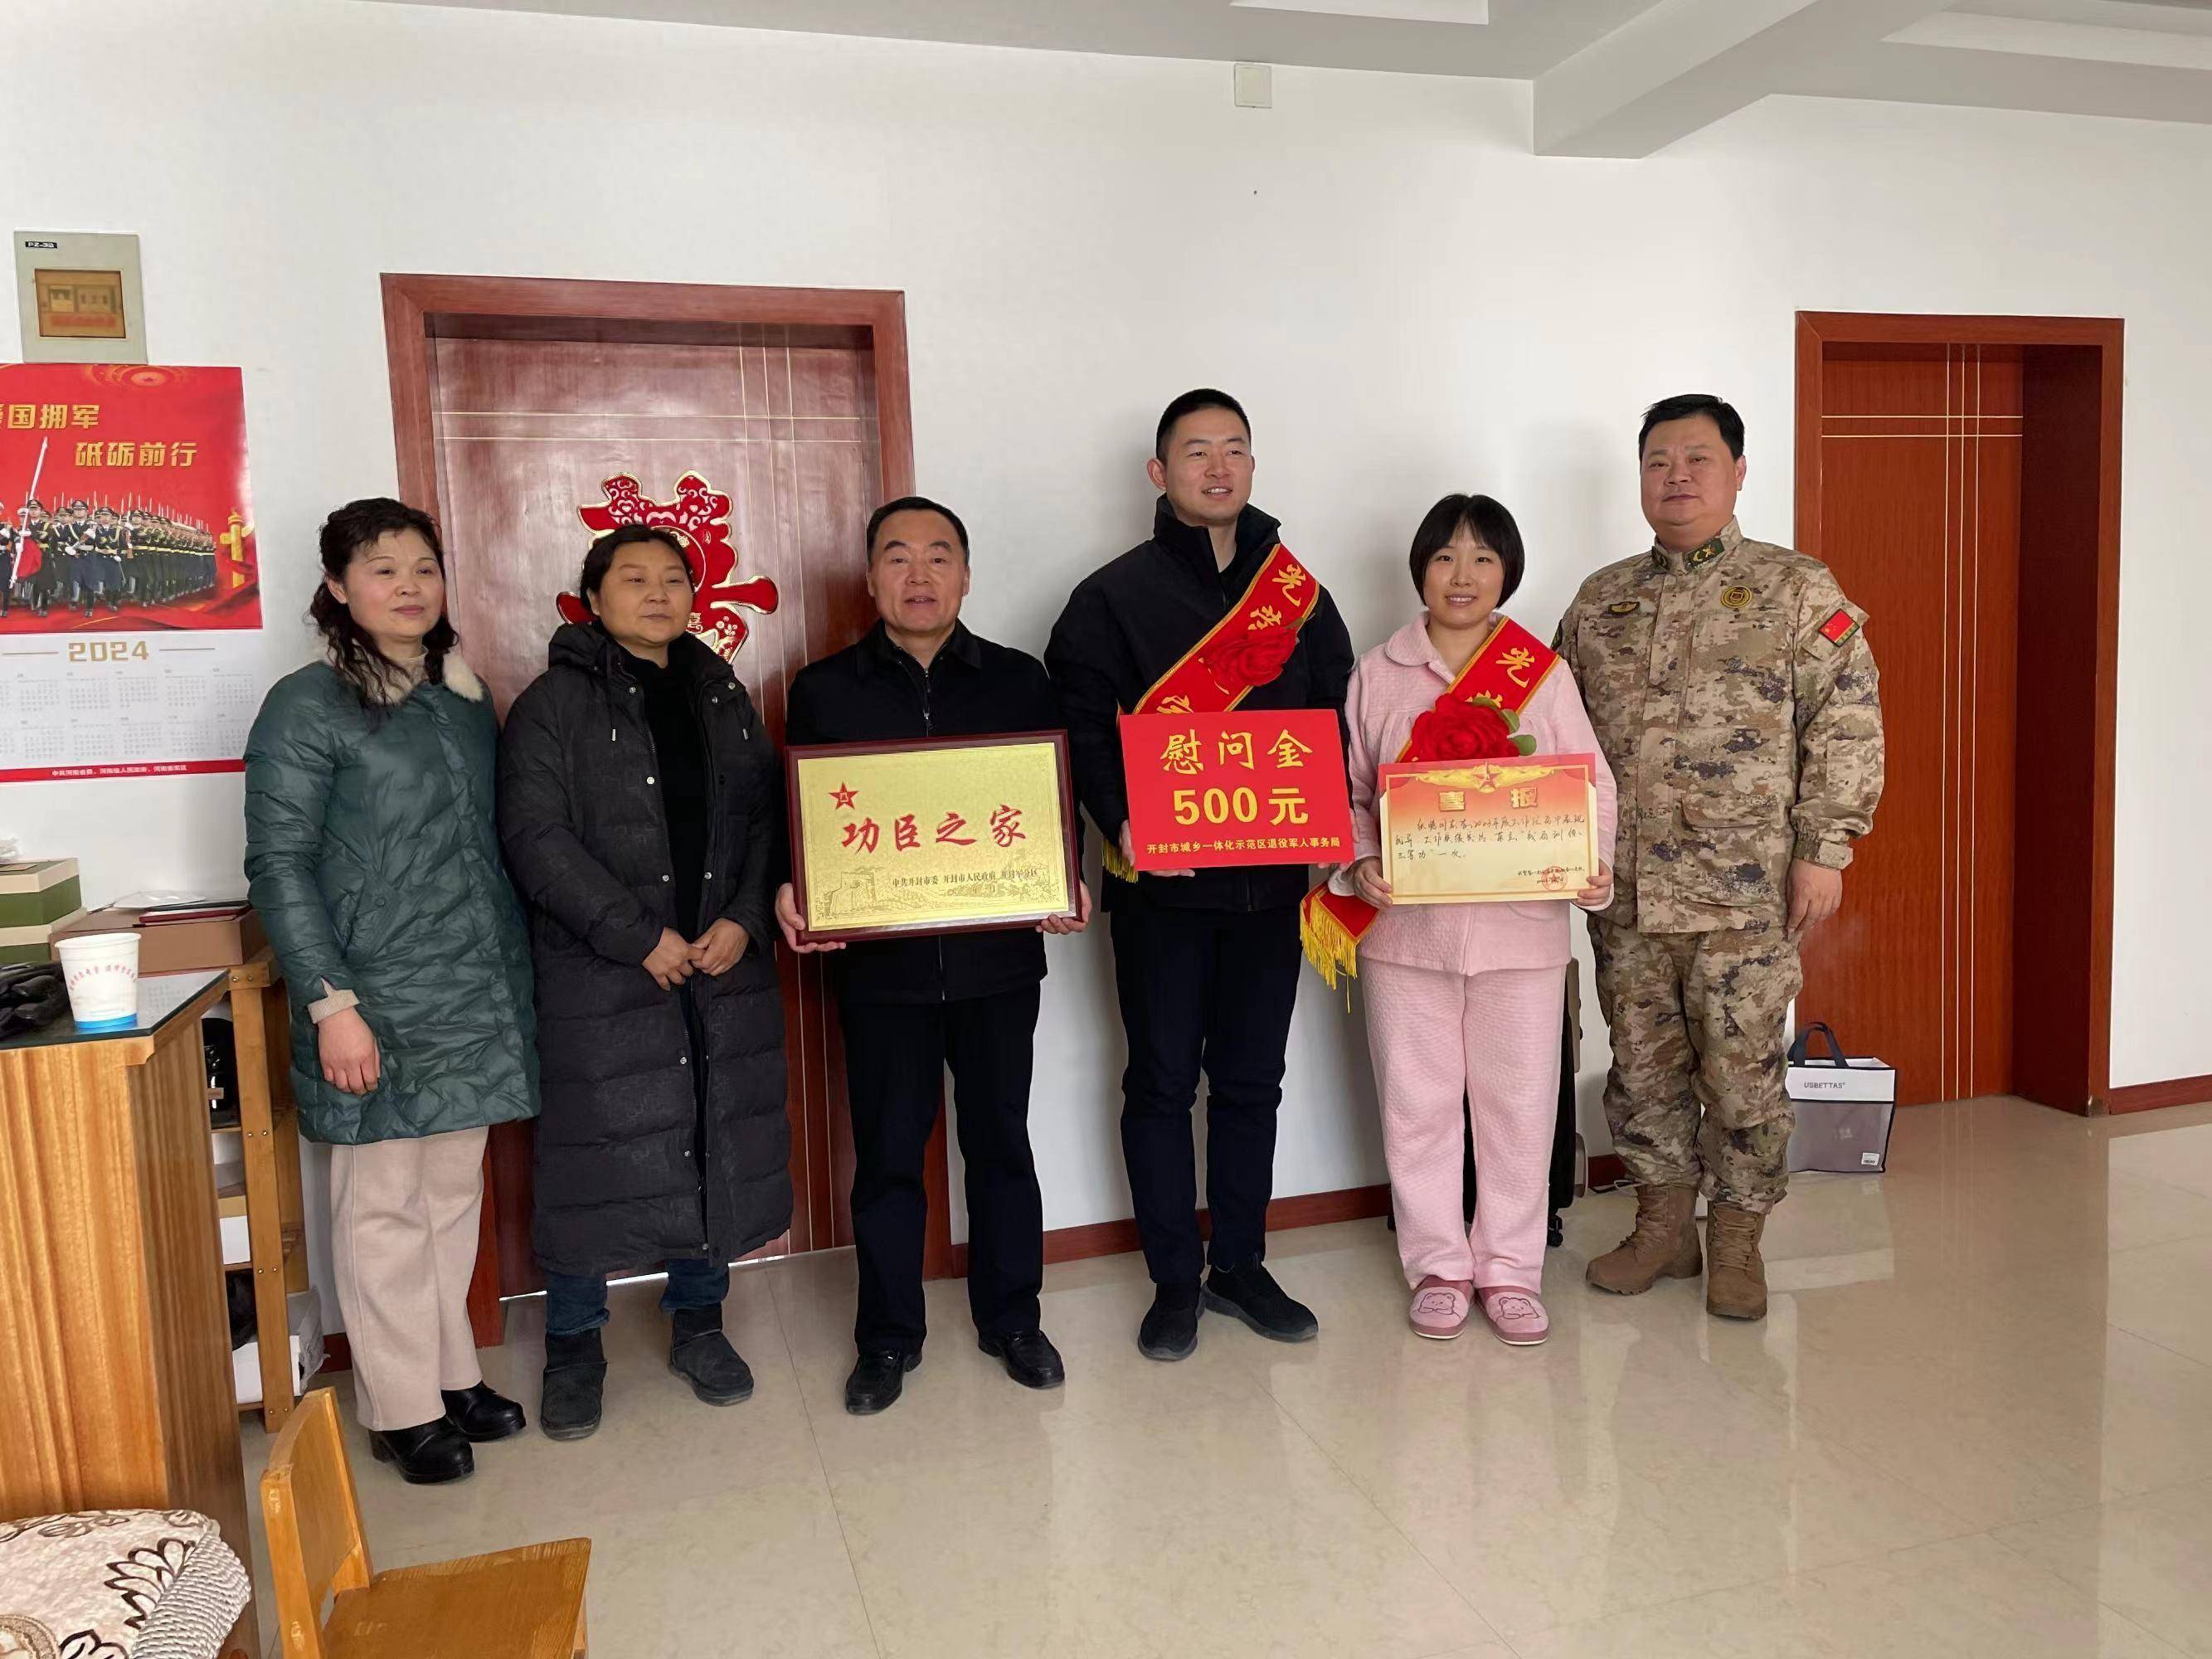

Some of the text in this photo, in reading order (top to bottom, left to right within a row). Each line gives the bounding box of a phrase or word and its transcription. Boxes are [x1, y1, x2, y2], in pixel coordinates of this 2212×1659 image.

[0, 404, 100, 429] 国拥军
[75, 441, 198, 468] 砥砺前行
[68, 640, 149, 662] 2024
[1159, 728, 1314, 775] 慰问金
[842, 804, 1027, 855] 功臣之家
[1146, 836, 1341, 854] 开封市城乡一体化示范区退役军人事务局
[892, 875, 940, 888] 中共开封市委
[943, 871, 995, 884] 开封市人民政府
